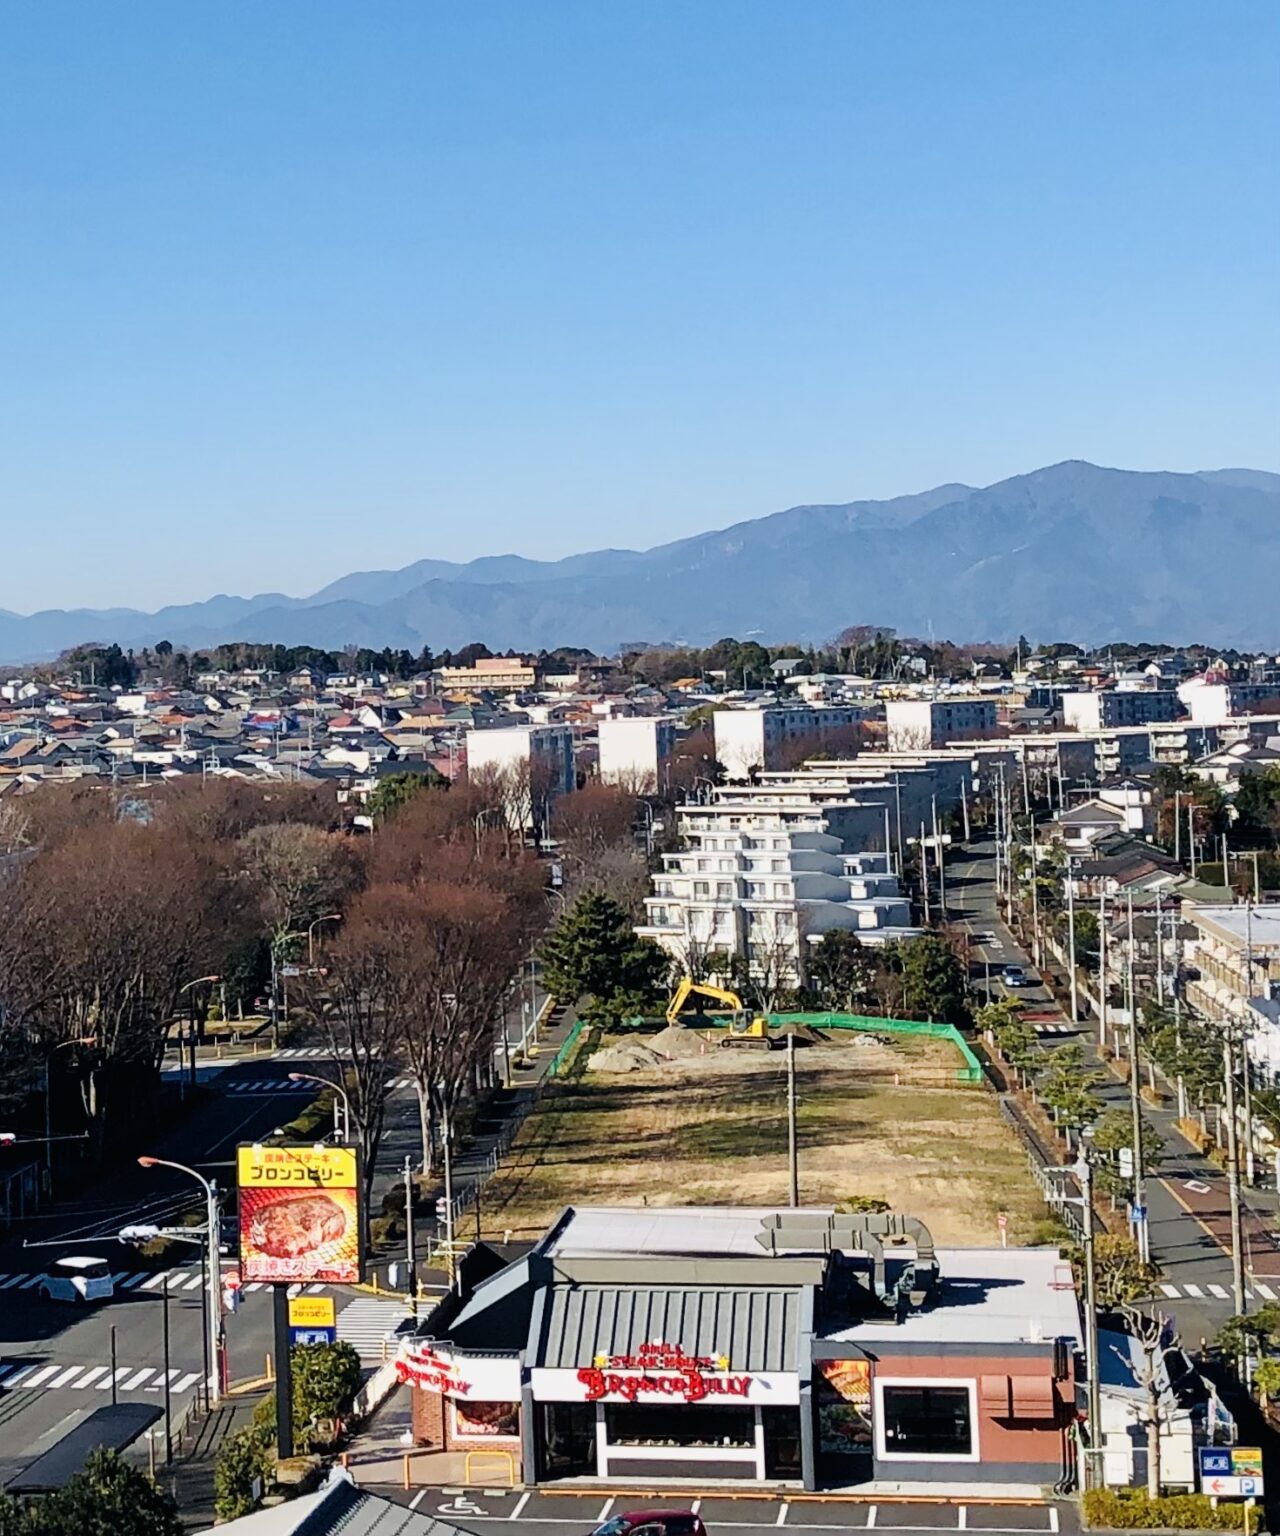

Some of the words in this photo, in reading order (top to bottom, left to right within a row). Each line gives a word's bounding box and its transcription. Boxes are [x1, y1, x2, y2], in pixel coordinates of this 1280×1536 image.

[250, 1165, 344, 1180] ブロンコビリー
